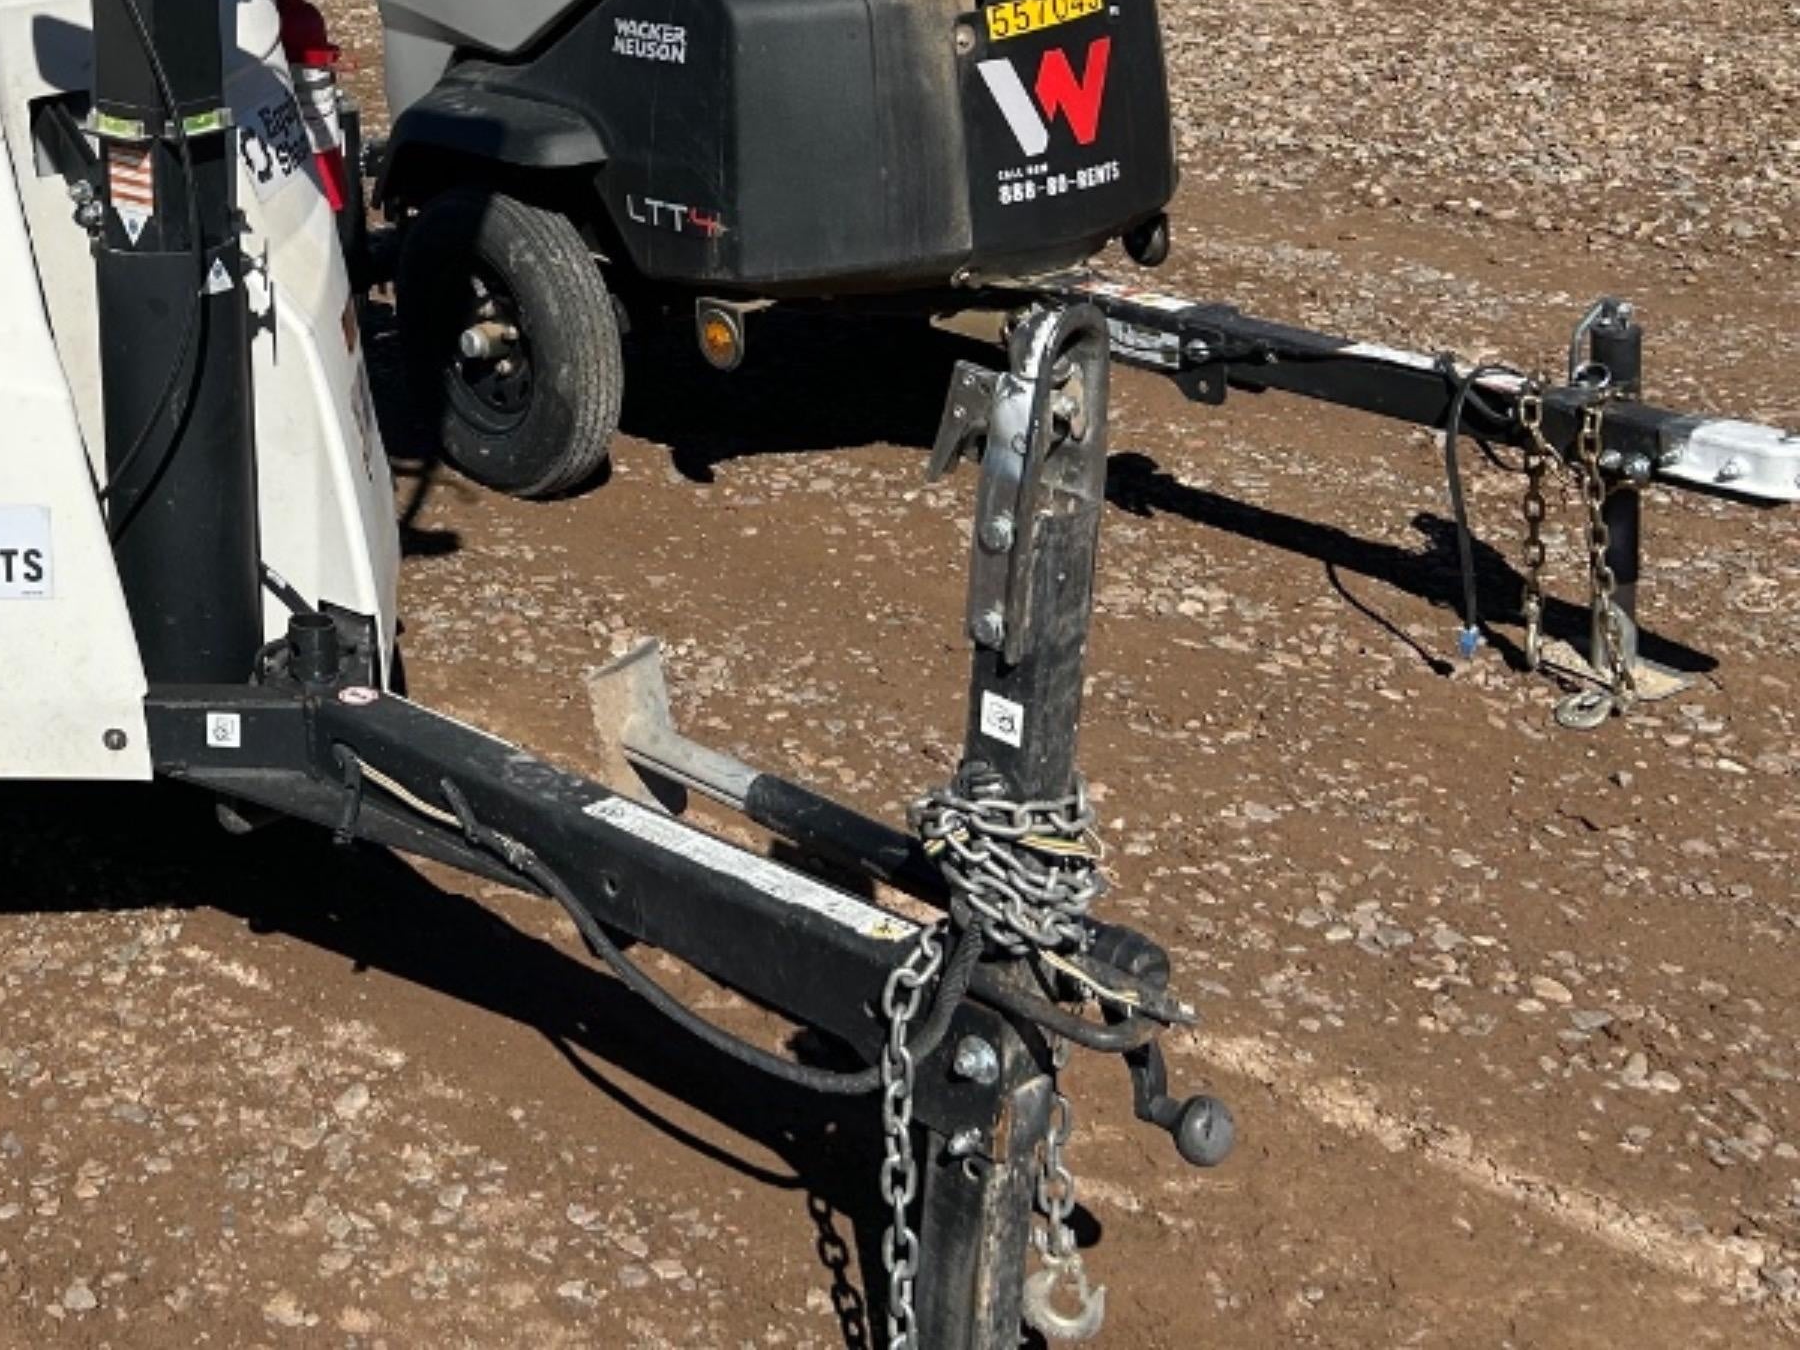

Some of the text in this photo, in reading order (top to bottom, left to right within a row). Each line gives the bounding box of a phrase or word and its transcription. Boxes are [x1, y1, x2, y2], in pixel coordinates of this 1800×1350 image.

[613, 17, 686, 46] WACKER
[611, 35, 686, 65] NEUSON
[998, 159, 1120, 206] 888-80-RENTS
